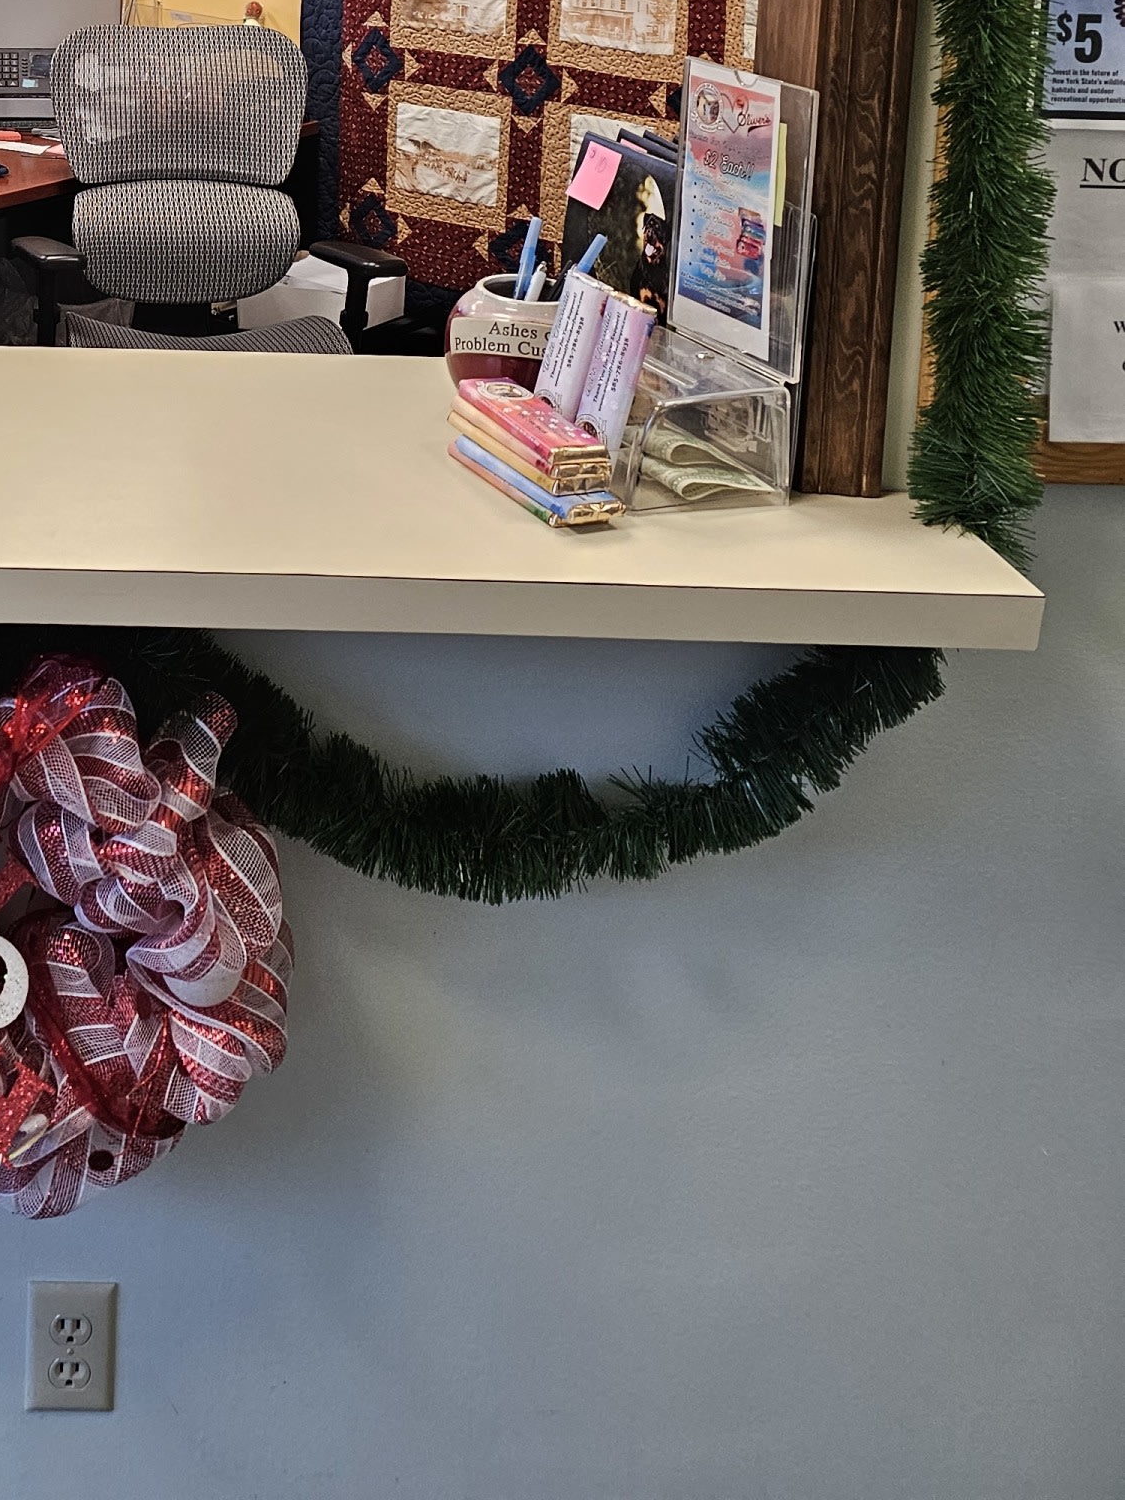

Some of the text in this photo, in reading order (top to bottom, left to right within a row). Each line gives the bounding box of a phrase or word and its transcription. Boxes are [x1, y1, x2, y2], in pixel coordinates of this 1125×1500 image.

[1056, 9, 1102, 63] $5
[1077, 86, 1089, 94] and
[704, 148, 718, 169] $2
[488, 321, 538, 339] Ashes
[455, 336, 510, 353] Problem
